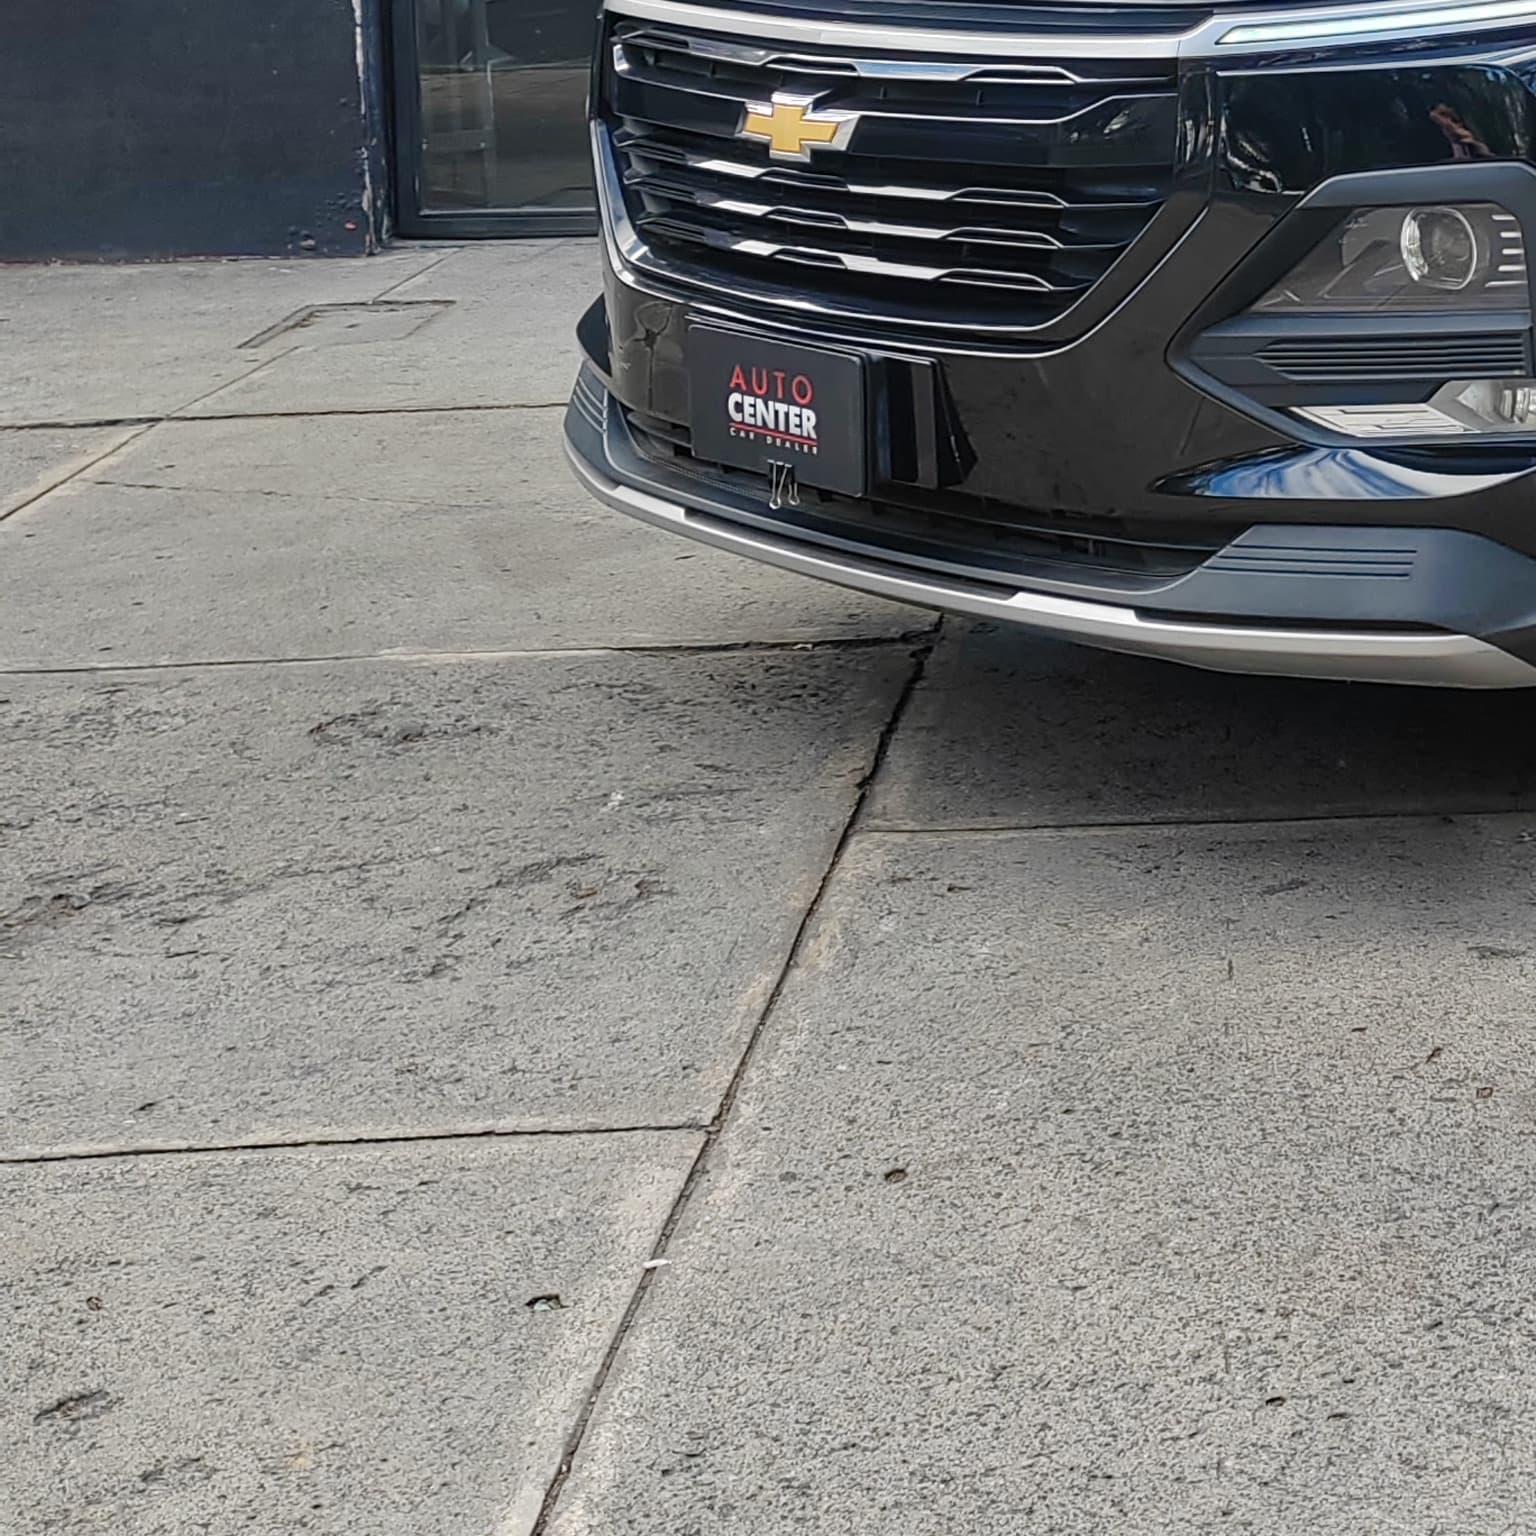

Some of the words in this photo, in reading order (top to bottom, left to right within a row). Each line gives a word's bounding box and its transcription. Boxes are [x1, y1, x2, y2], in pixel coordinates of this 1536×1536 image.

[729, 365, 813, 405] AUTO
[728, 392, 817, 439] CENTER
[729, 427, 755, 441] CAR
[766, 435, 818, 455] DEALER
